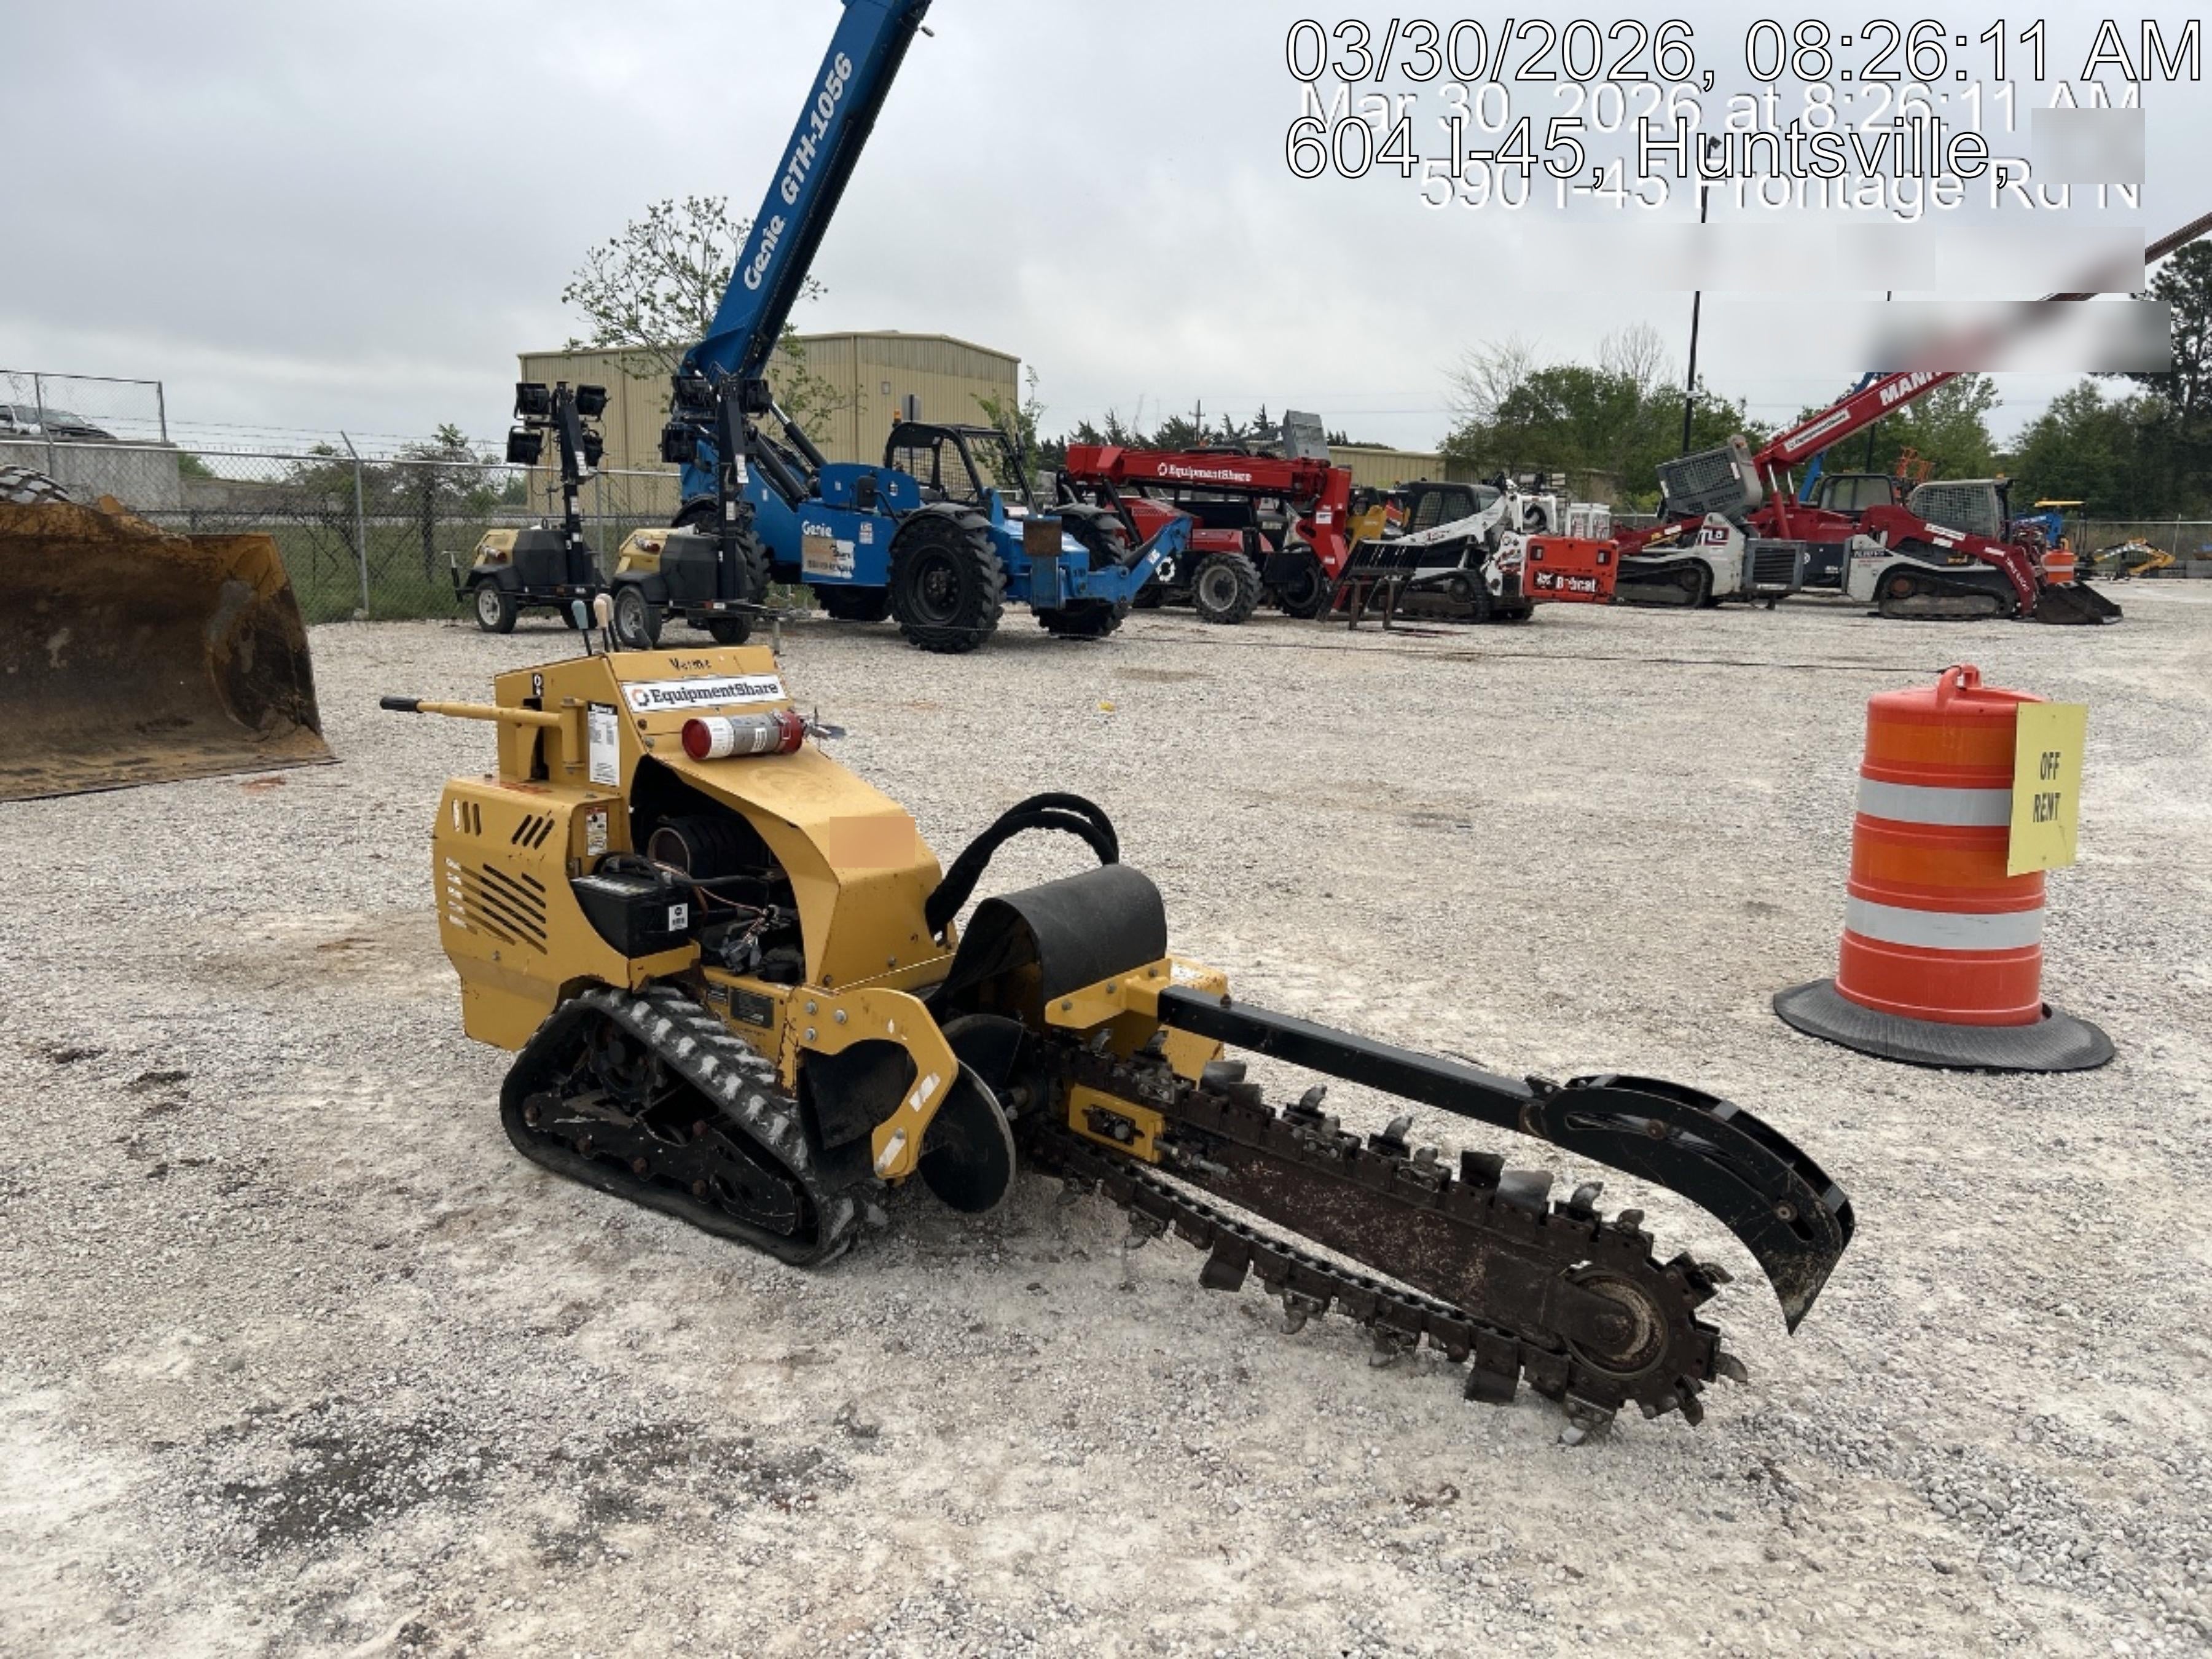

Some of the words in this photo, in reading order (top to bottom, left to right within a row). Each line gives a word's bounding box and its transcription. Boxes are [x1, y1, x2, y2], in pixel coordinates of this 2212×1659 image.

[744, 214, 785, 290] Genie
[780, 52, 852, 205] GTH-1056
[649, 683, 779, 704] EquipmentShare
[2039, 751, 2061, 780] OFF
[2033, 792, 2061, 823] RENT
